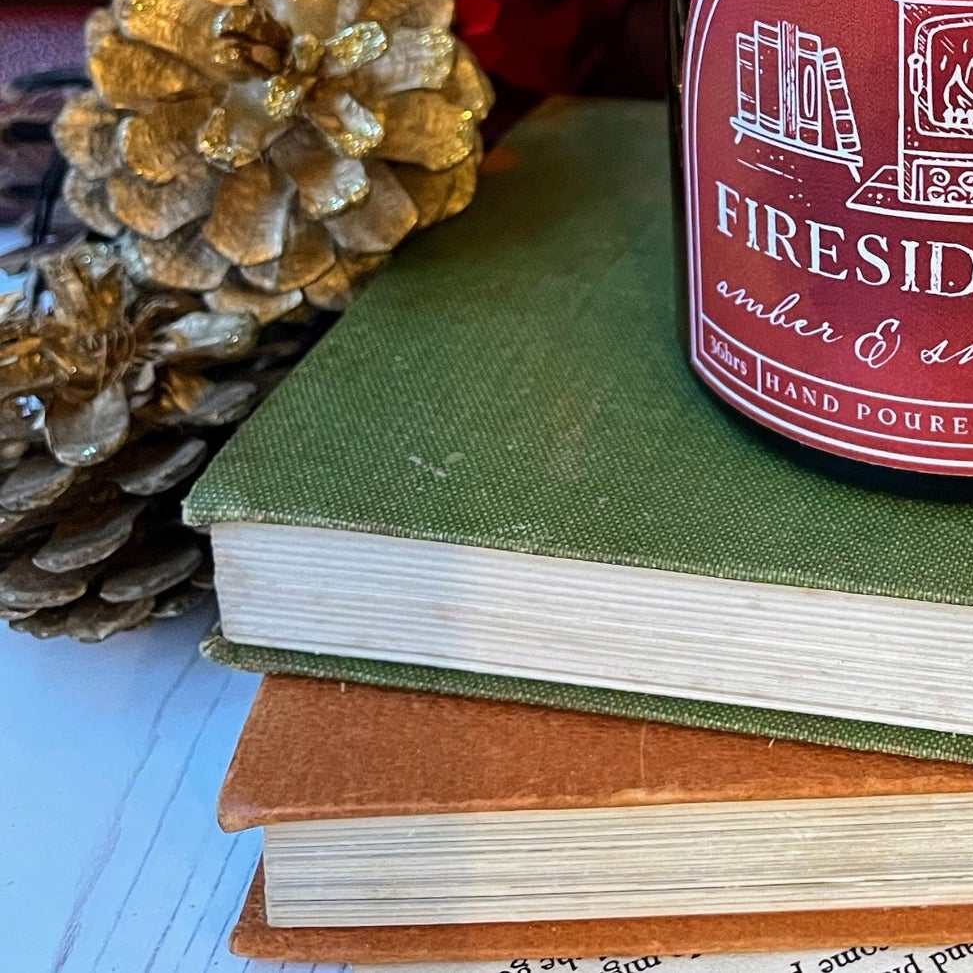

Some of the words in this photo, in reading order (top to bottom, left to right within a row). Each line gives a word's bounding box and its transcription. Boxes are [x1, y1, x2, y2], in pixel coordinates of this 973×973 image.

[716, 280, 843, 343] amber
[854, 318, 901, 368] &
[765, 371, 840, 413] HAND
